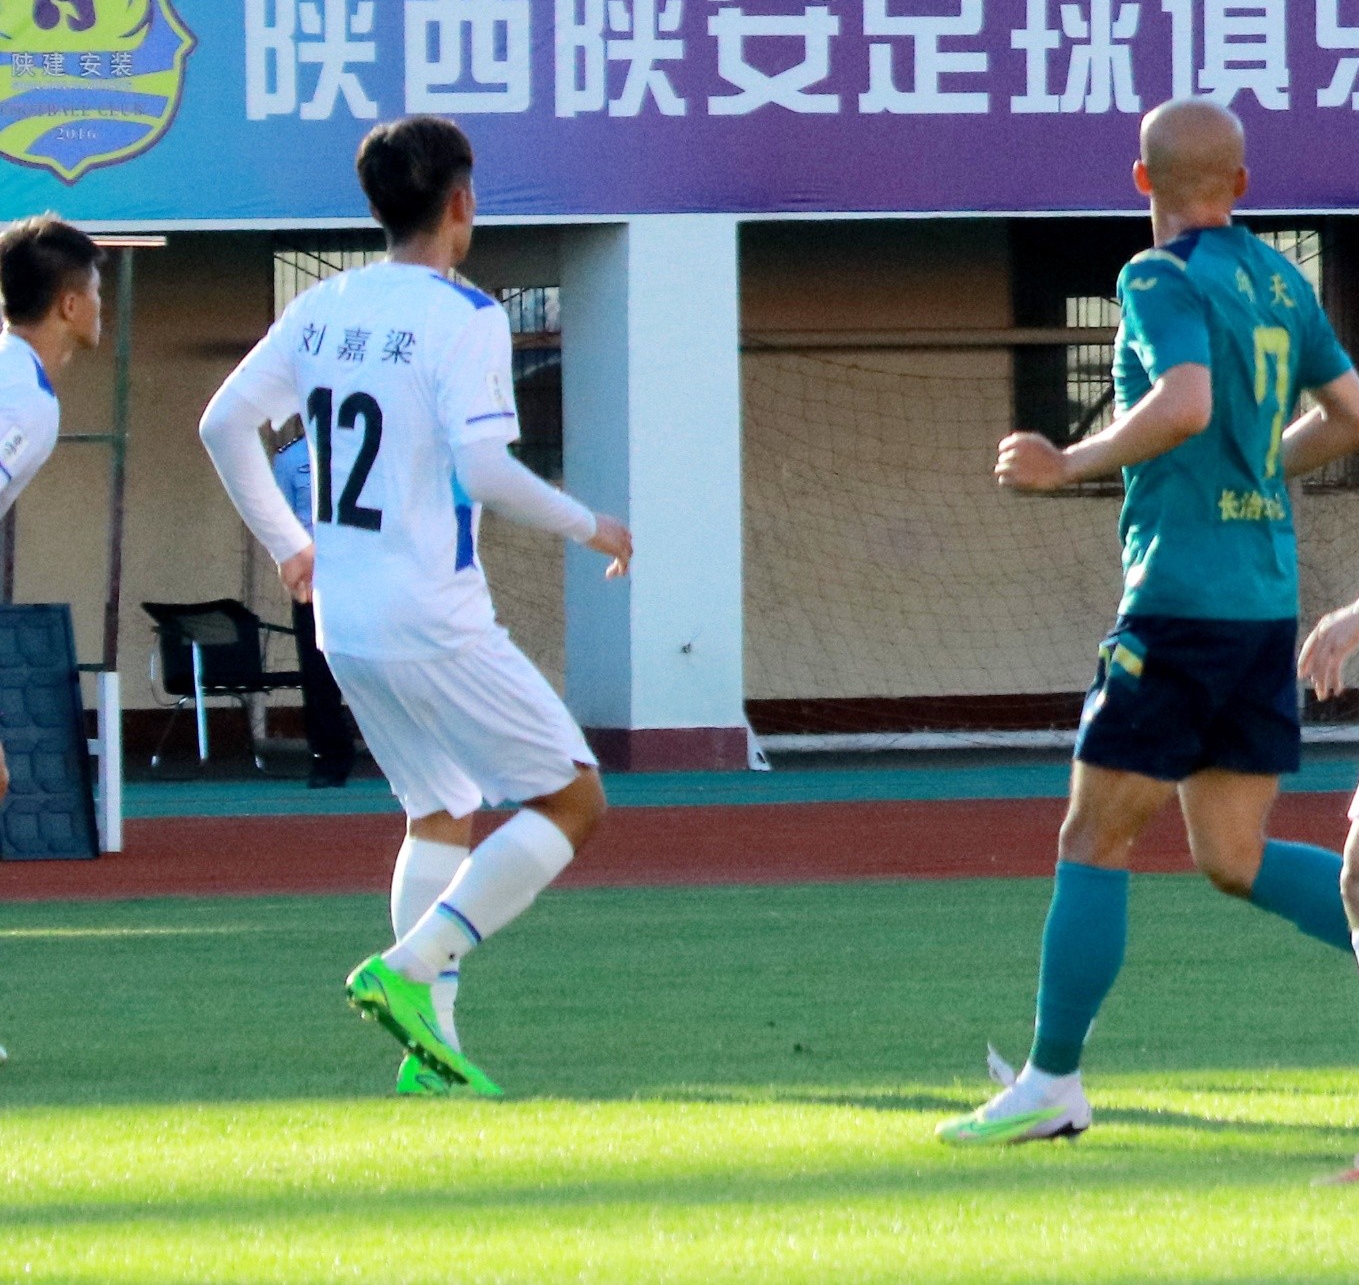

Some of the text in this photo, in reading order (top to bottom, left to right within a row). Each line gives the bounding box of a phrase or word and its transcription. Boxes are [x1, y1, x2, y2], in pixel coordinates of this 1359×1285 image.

[11, 52, 133, 77] 陕建安装
[55, 127, 98, 141] 2016
[298, 321, 417, 365] 刘嘉梁
[1254, 326, 1290, 478] 7
[306, 385, 383, 532] 12
